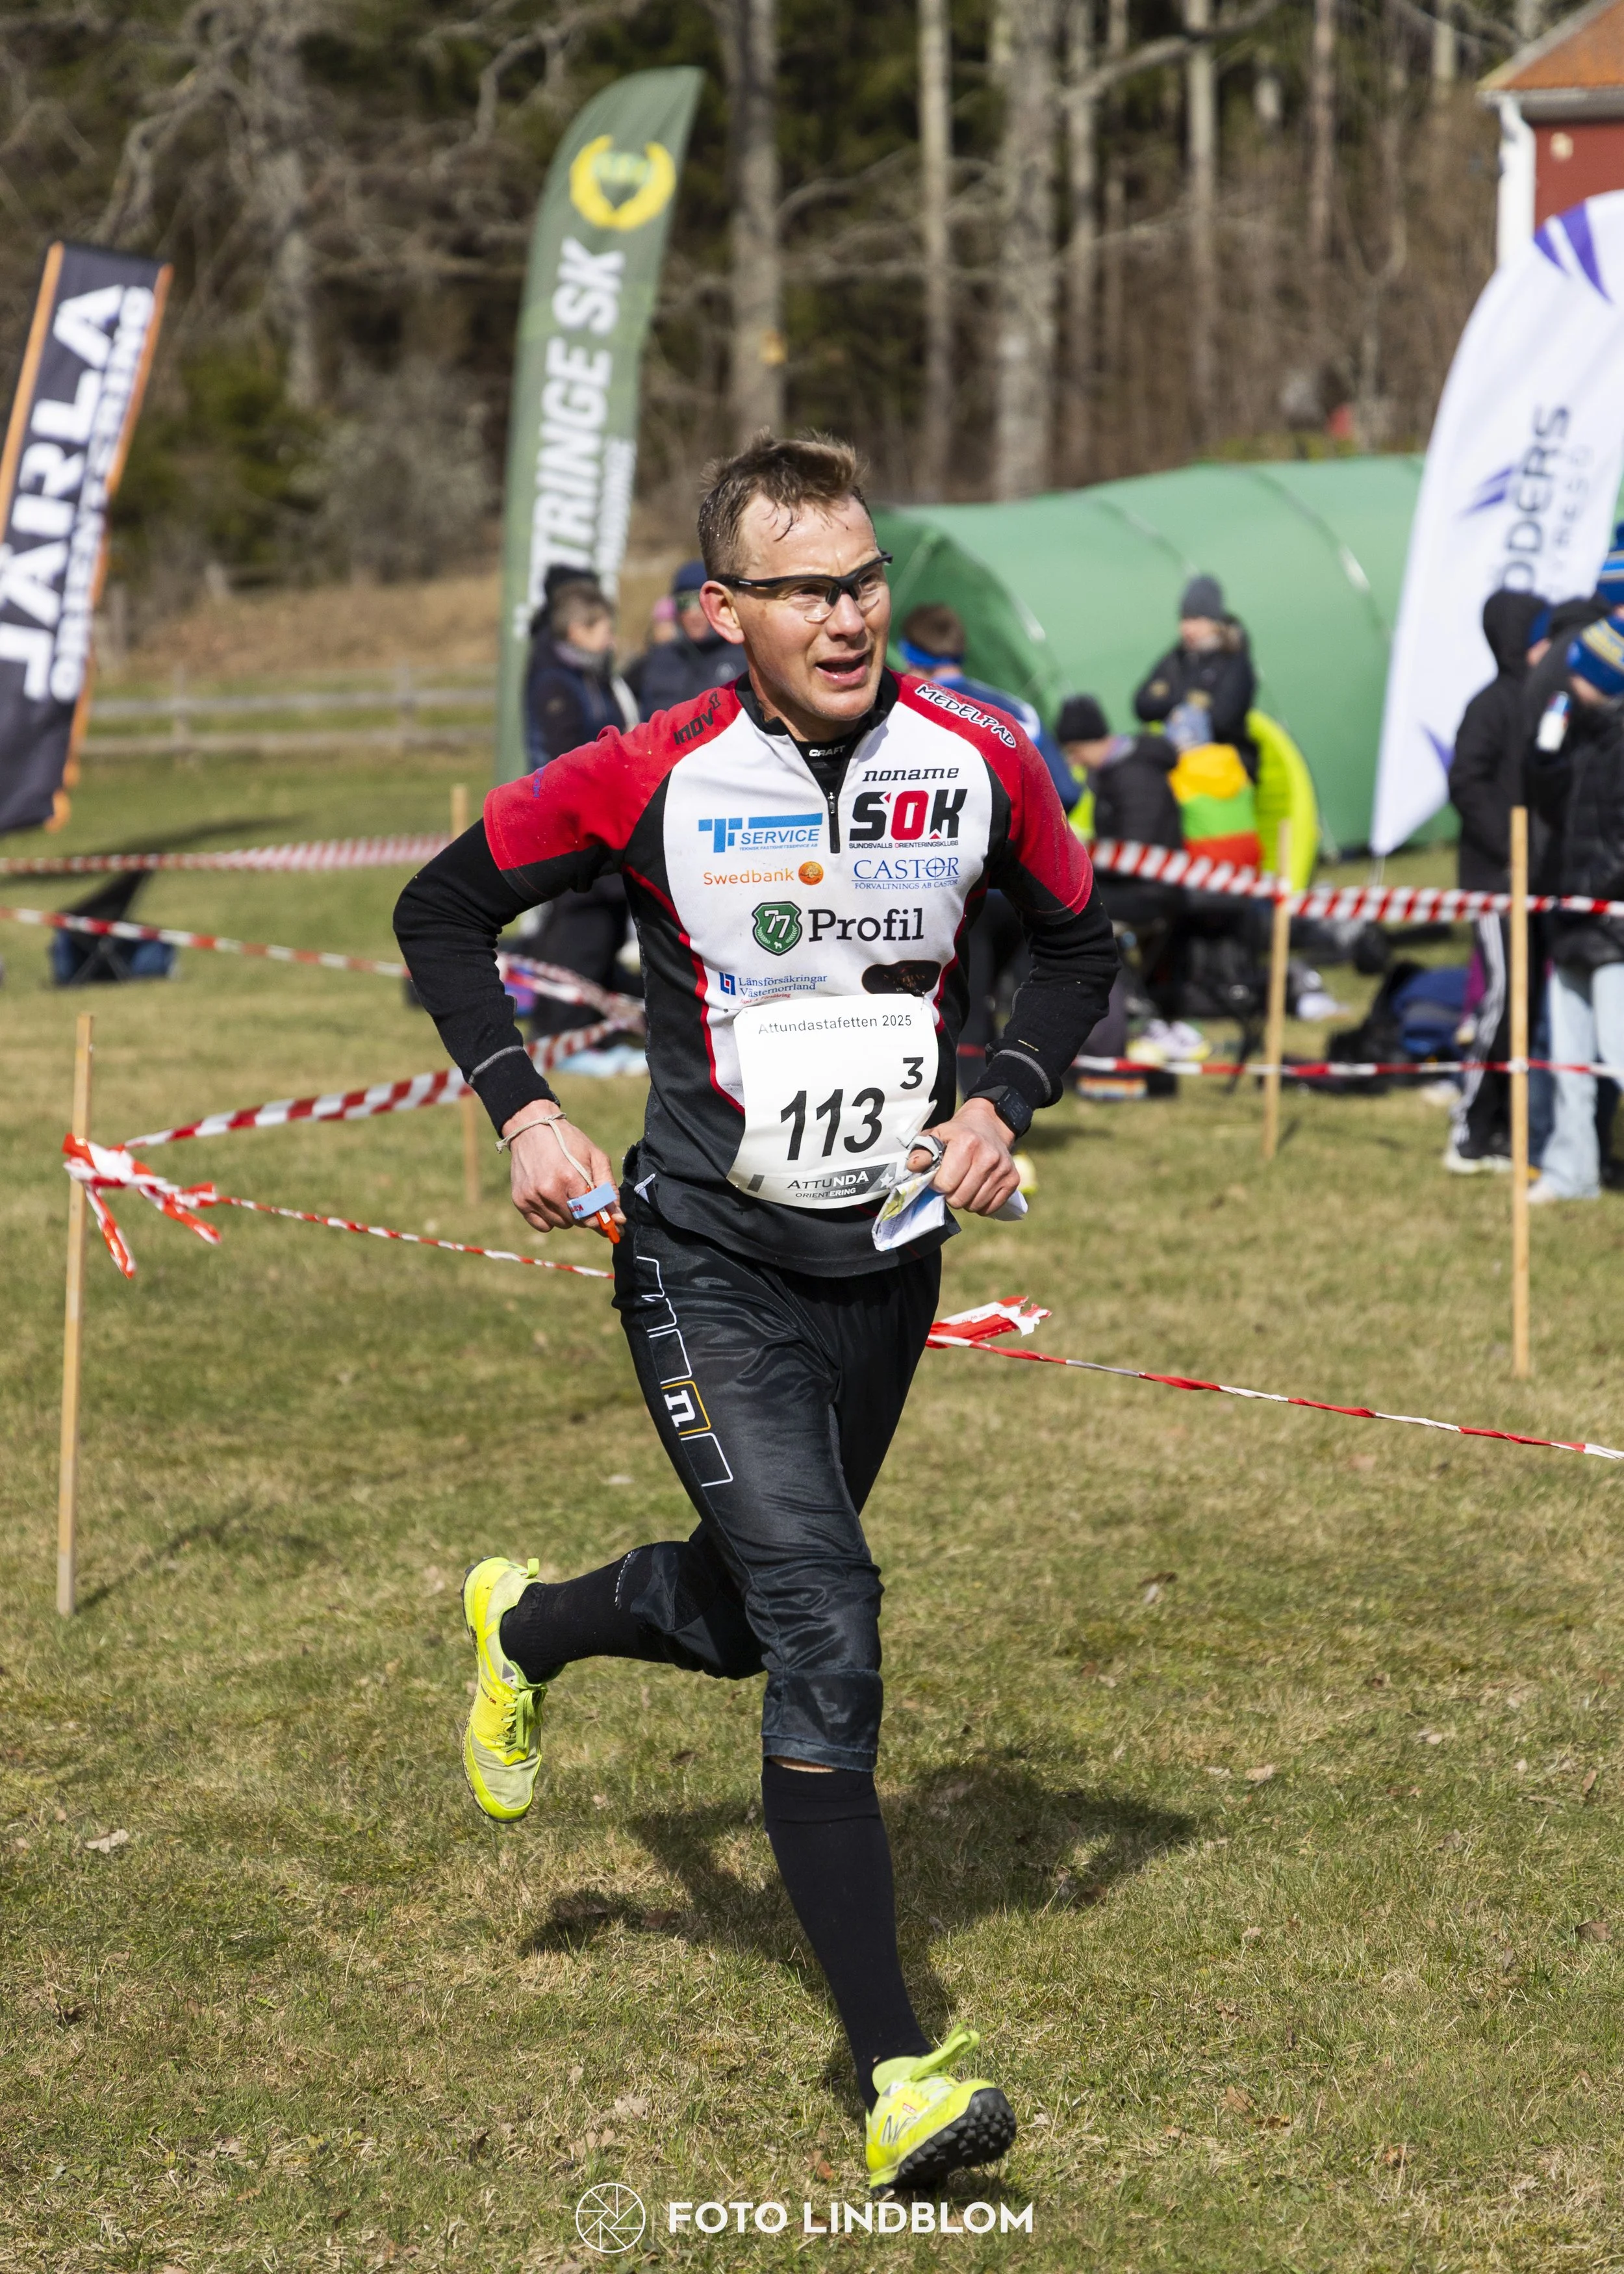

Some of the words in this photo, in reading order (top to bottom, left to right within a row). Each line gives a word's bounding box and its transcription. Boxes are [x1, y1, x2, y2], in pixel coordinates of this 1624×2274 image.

[552, 236, 626, 336] SK
[513, 337, 613, 640] TRINGE
[917, 685, 1015, 747] MEDELPAD
[809, 745, 846, 757] CRAFT
[863, 767, 959, 782] noname
[741, 828, 820, 845] SERVICE
[894, 840, 959, 849] ORIENTERINGSKLUBB
[704, 868, 794, 886] Swedbank
[854, 856, 959, 880] CASTOR
[934, 879, 958, 888] CASTOR
[765, 910, 790, 938] 77
[808, 908, 924, 942] Profil
[738, 975, 828, 987] Länsförsäkringar
[740, 982, 816, 998] Västernorrland
[758, 1017, 878, 1034] Attundastafetten
[882, 1015, 912, 1027] 2025
[900, 1056, 924, 1090] 3
[780, 1087, 885, 1160] 113
[787, 1171, 869, 1189] ATTUNDA
[795, 1187, 856, 1198] ORIENTERING
